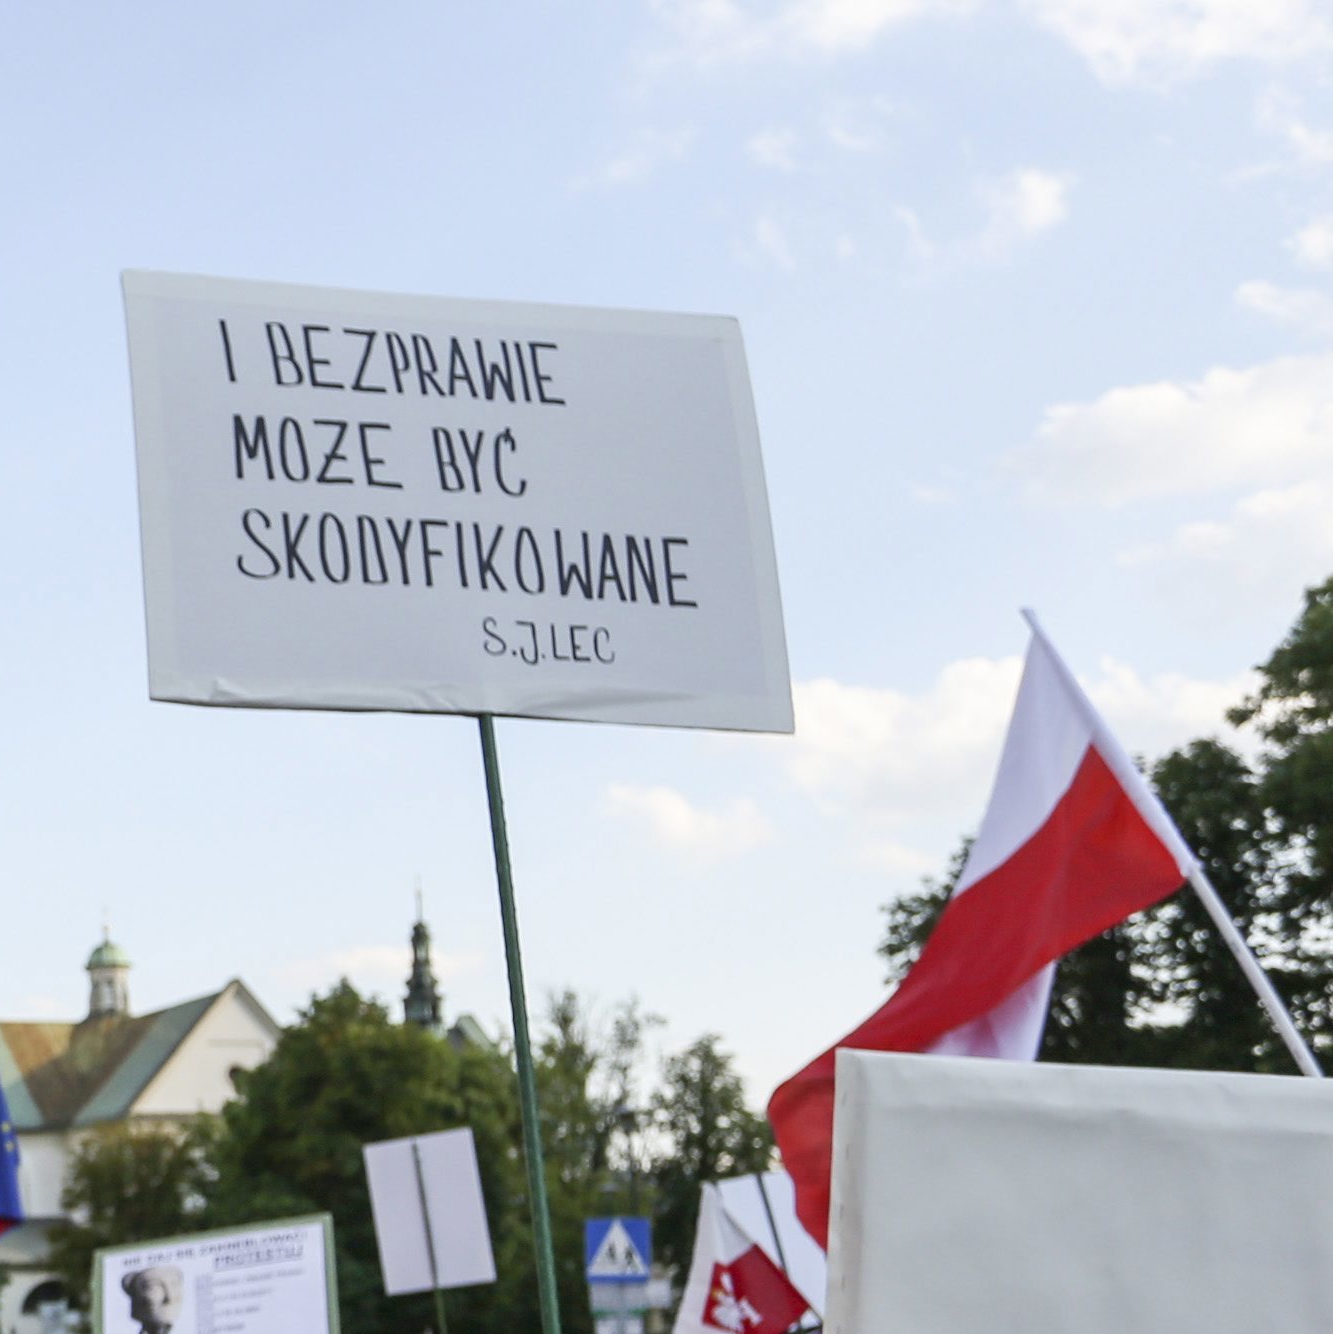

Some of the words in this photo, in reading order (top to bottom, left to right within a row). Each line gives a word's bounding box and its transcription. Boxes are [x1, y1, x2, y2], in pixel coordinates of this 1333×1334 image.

[219, 319, 237, 383] I
[265, 320, 566, 406] BEZPRAWIE
[237, 508, 698, 608] SKODYFIKOWANE
